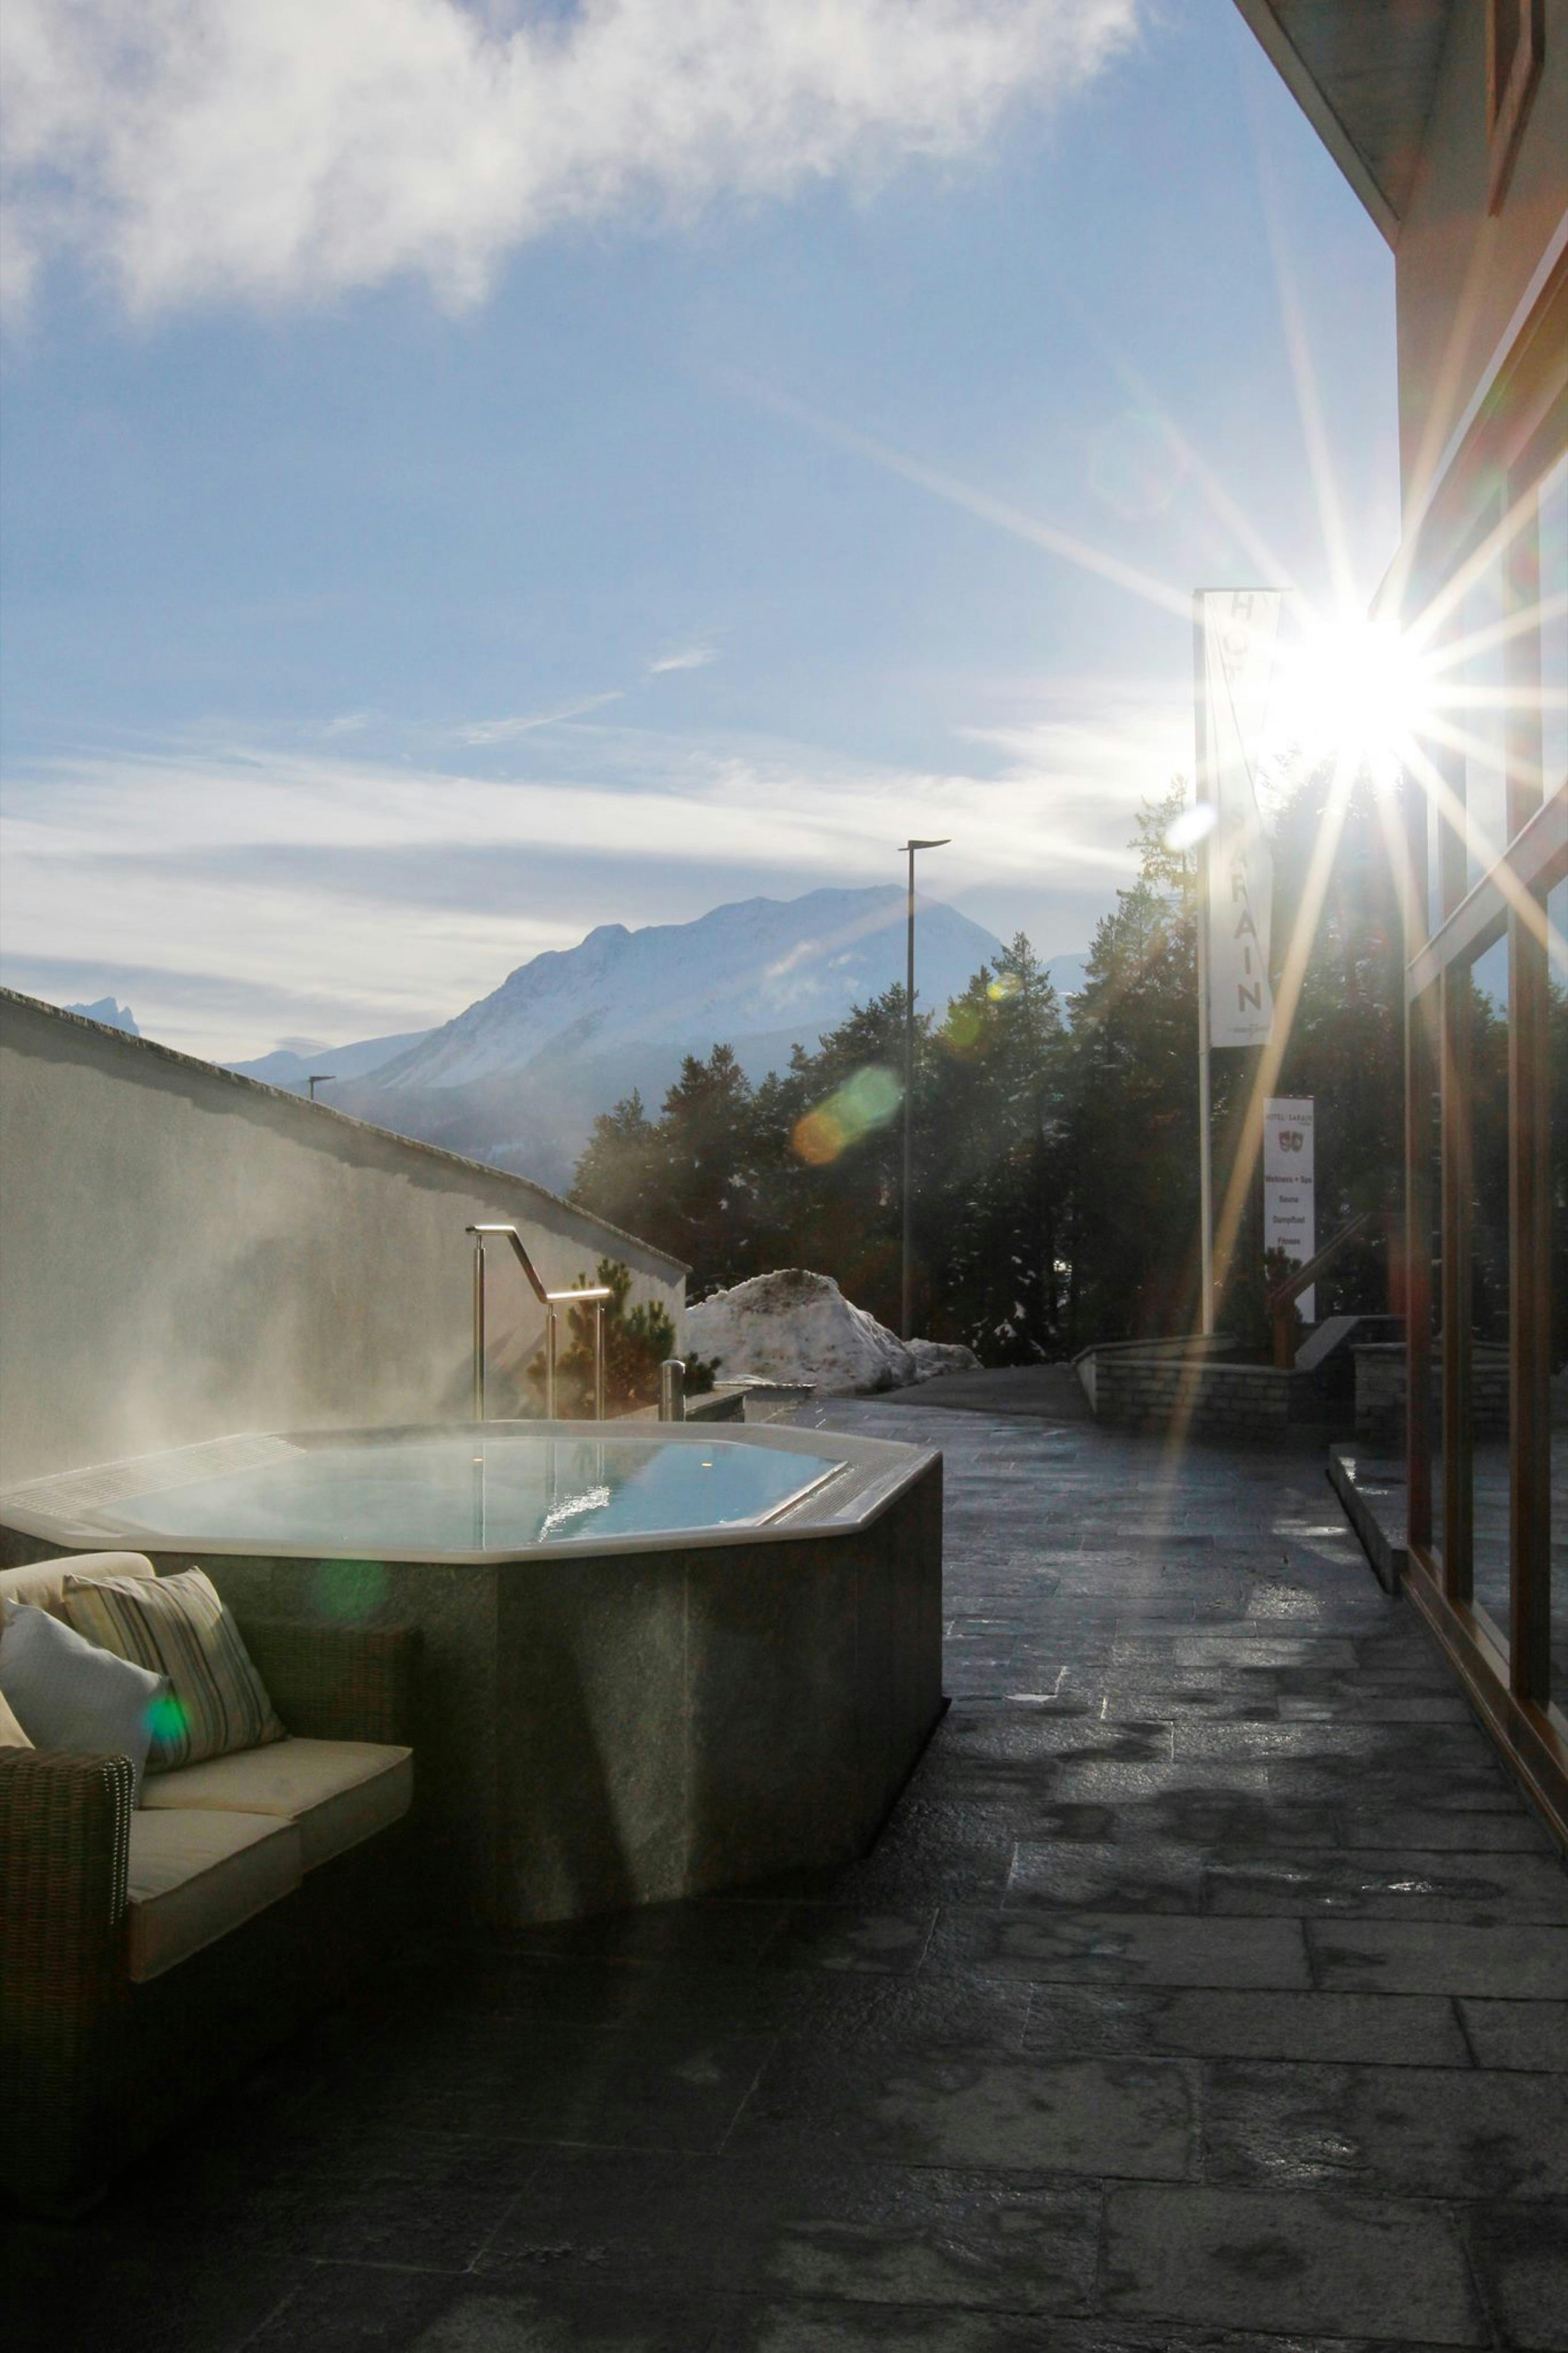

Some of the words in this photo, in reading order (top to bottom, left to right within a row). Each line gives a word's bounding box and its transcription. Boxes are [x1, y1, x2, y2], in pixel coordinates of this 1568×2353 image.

[1279, 1195, 1298, 1203] Sauna
[1273, 1215, 1305, 1225] Dampfbad
[1277, 1236, 1300, 1245] Fitness
